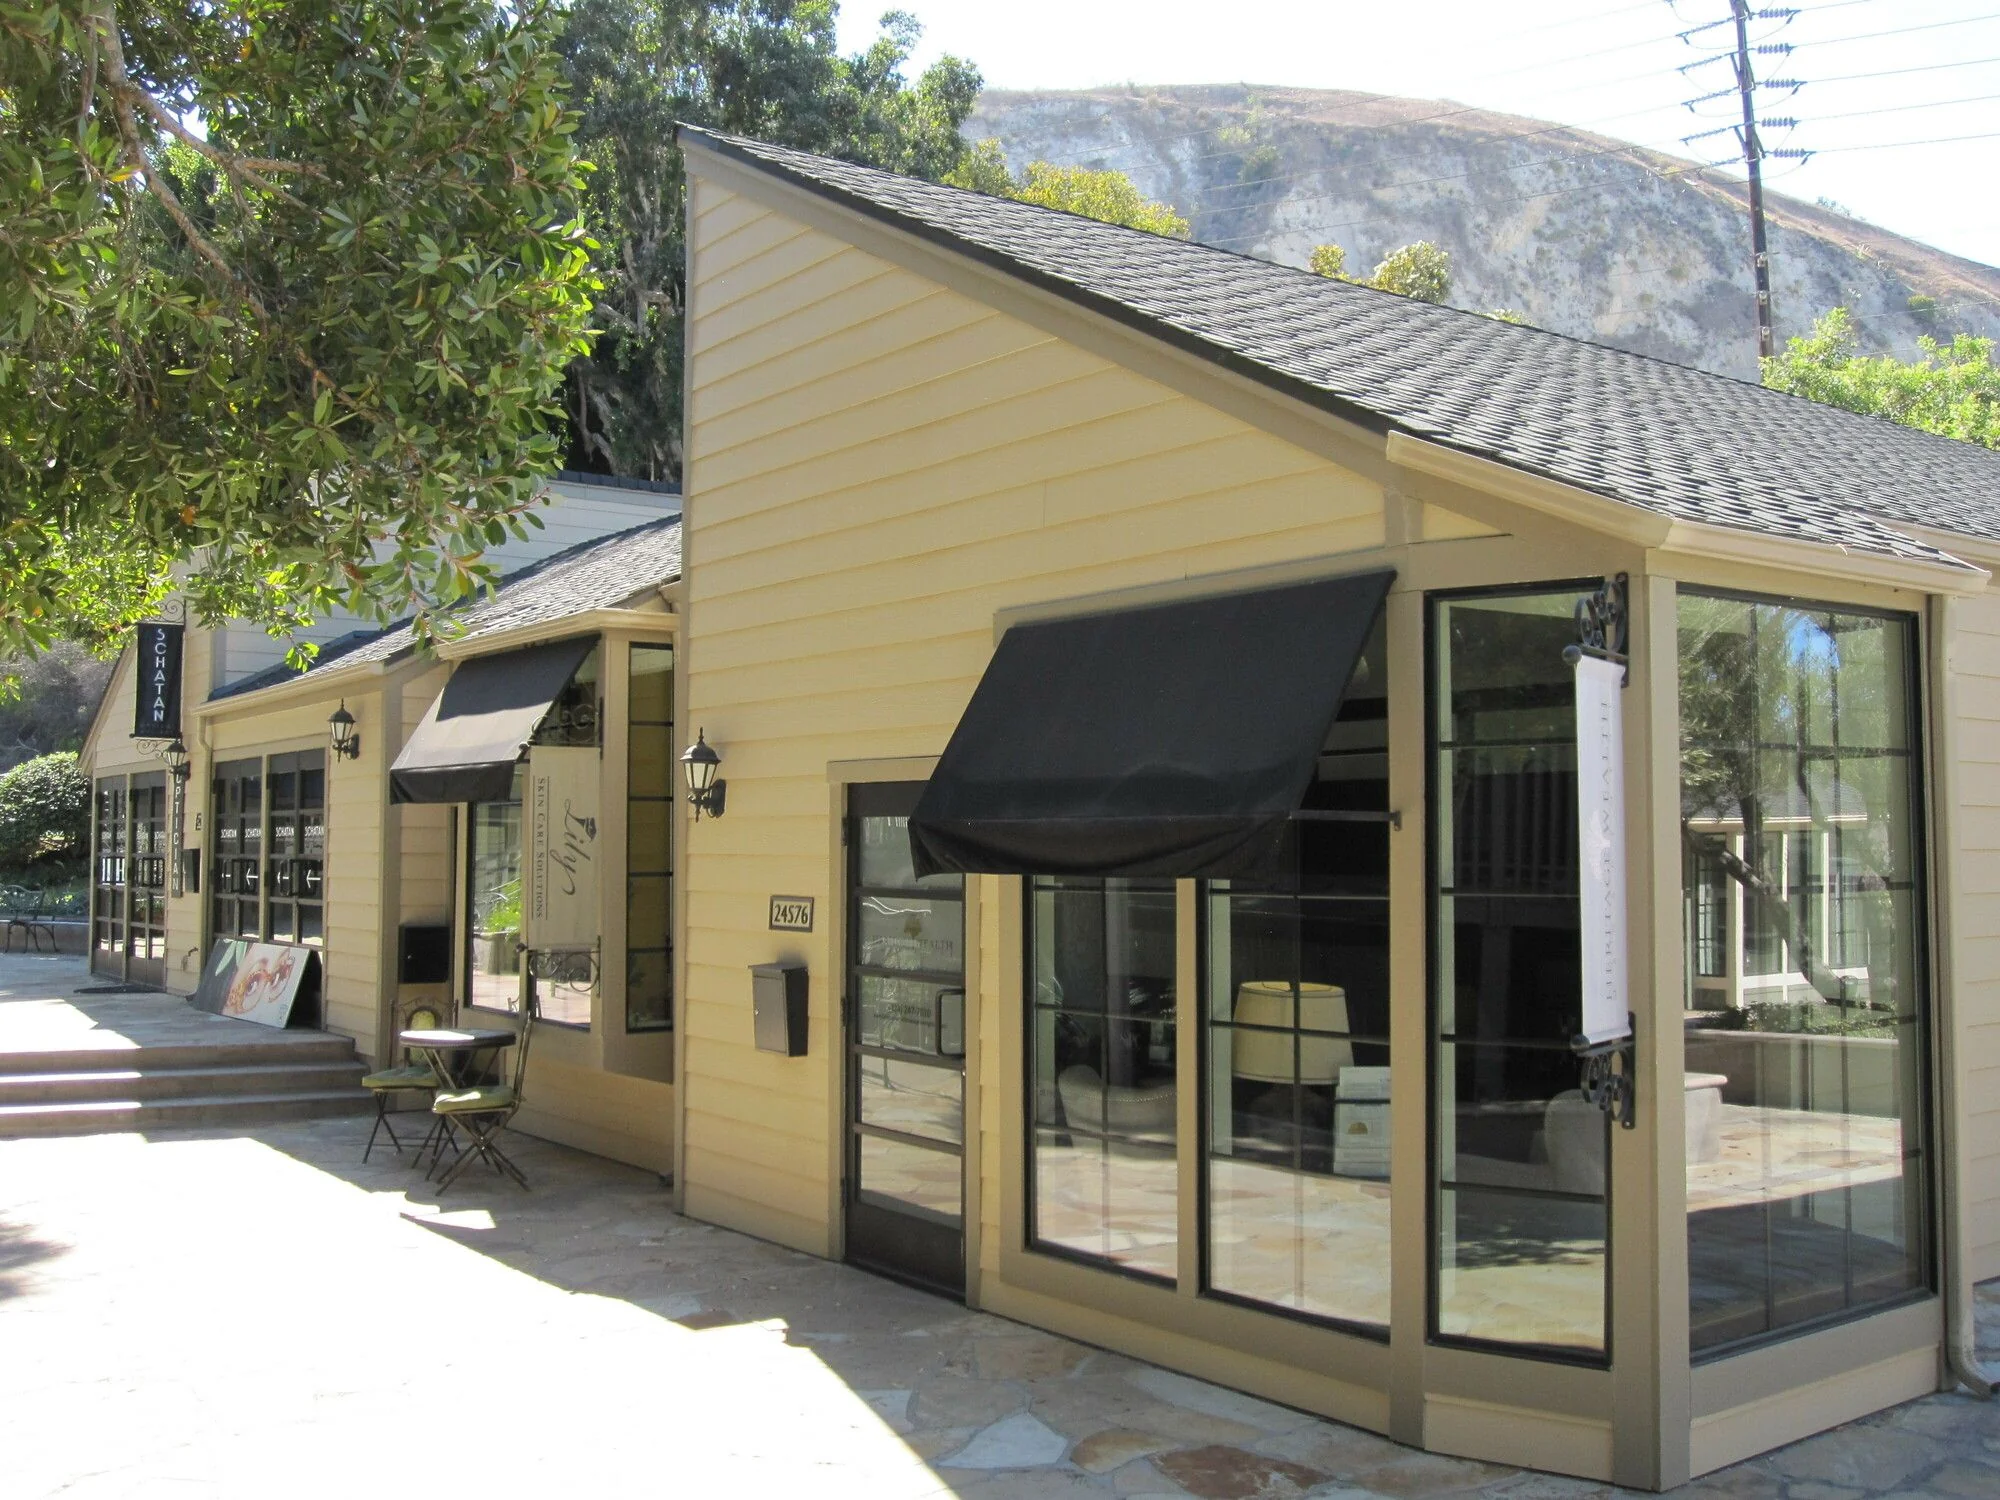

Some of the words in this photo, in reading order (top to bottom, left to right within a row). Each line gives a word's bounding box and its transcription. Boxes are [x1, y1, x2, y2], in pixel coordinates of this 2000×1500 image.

[153, 628, 167, 722] SCHATAN
[537, 777, 546, 807] SKIN
[536, 813, 546, 846] CARE
[550, 798, 597, 896] Lily
[535, 852, 545, 919] SOLUTIONS
[773, 903, 809, 925] 24576
